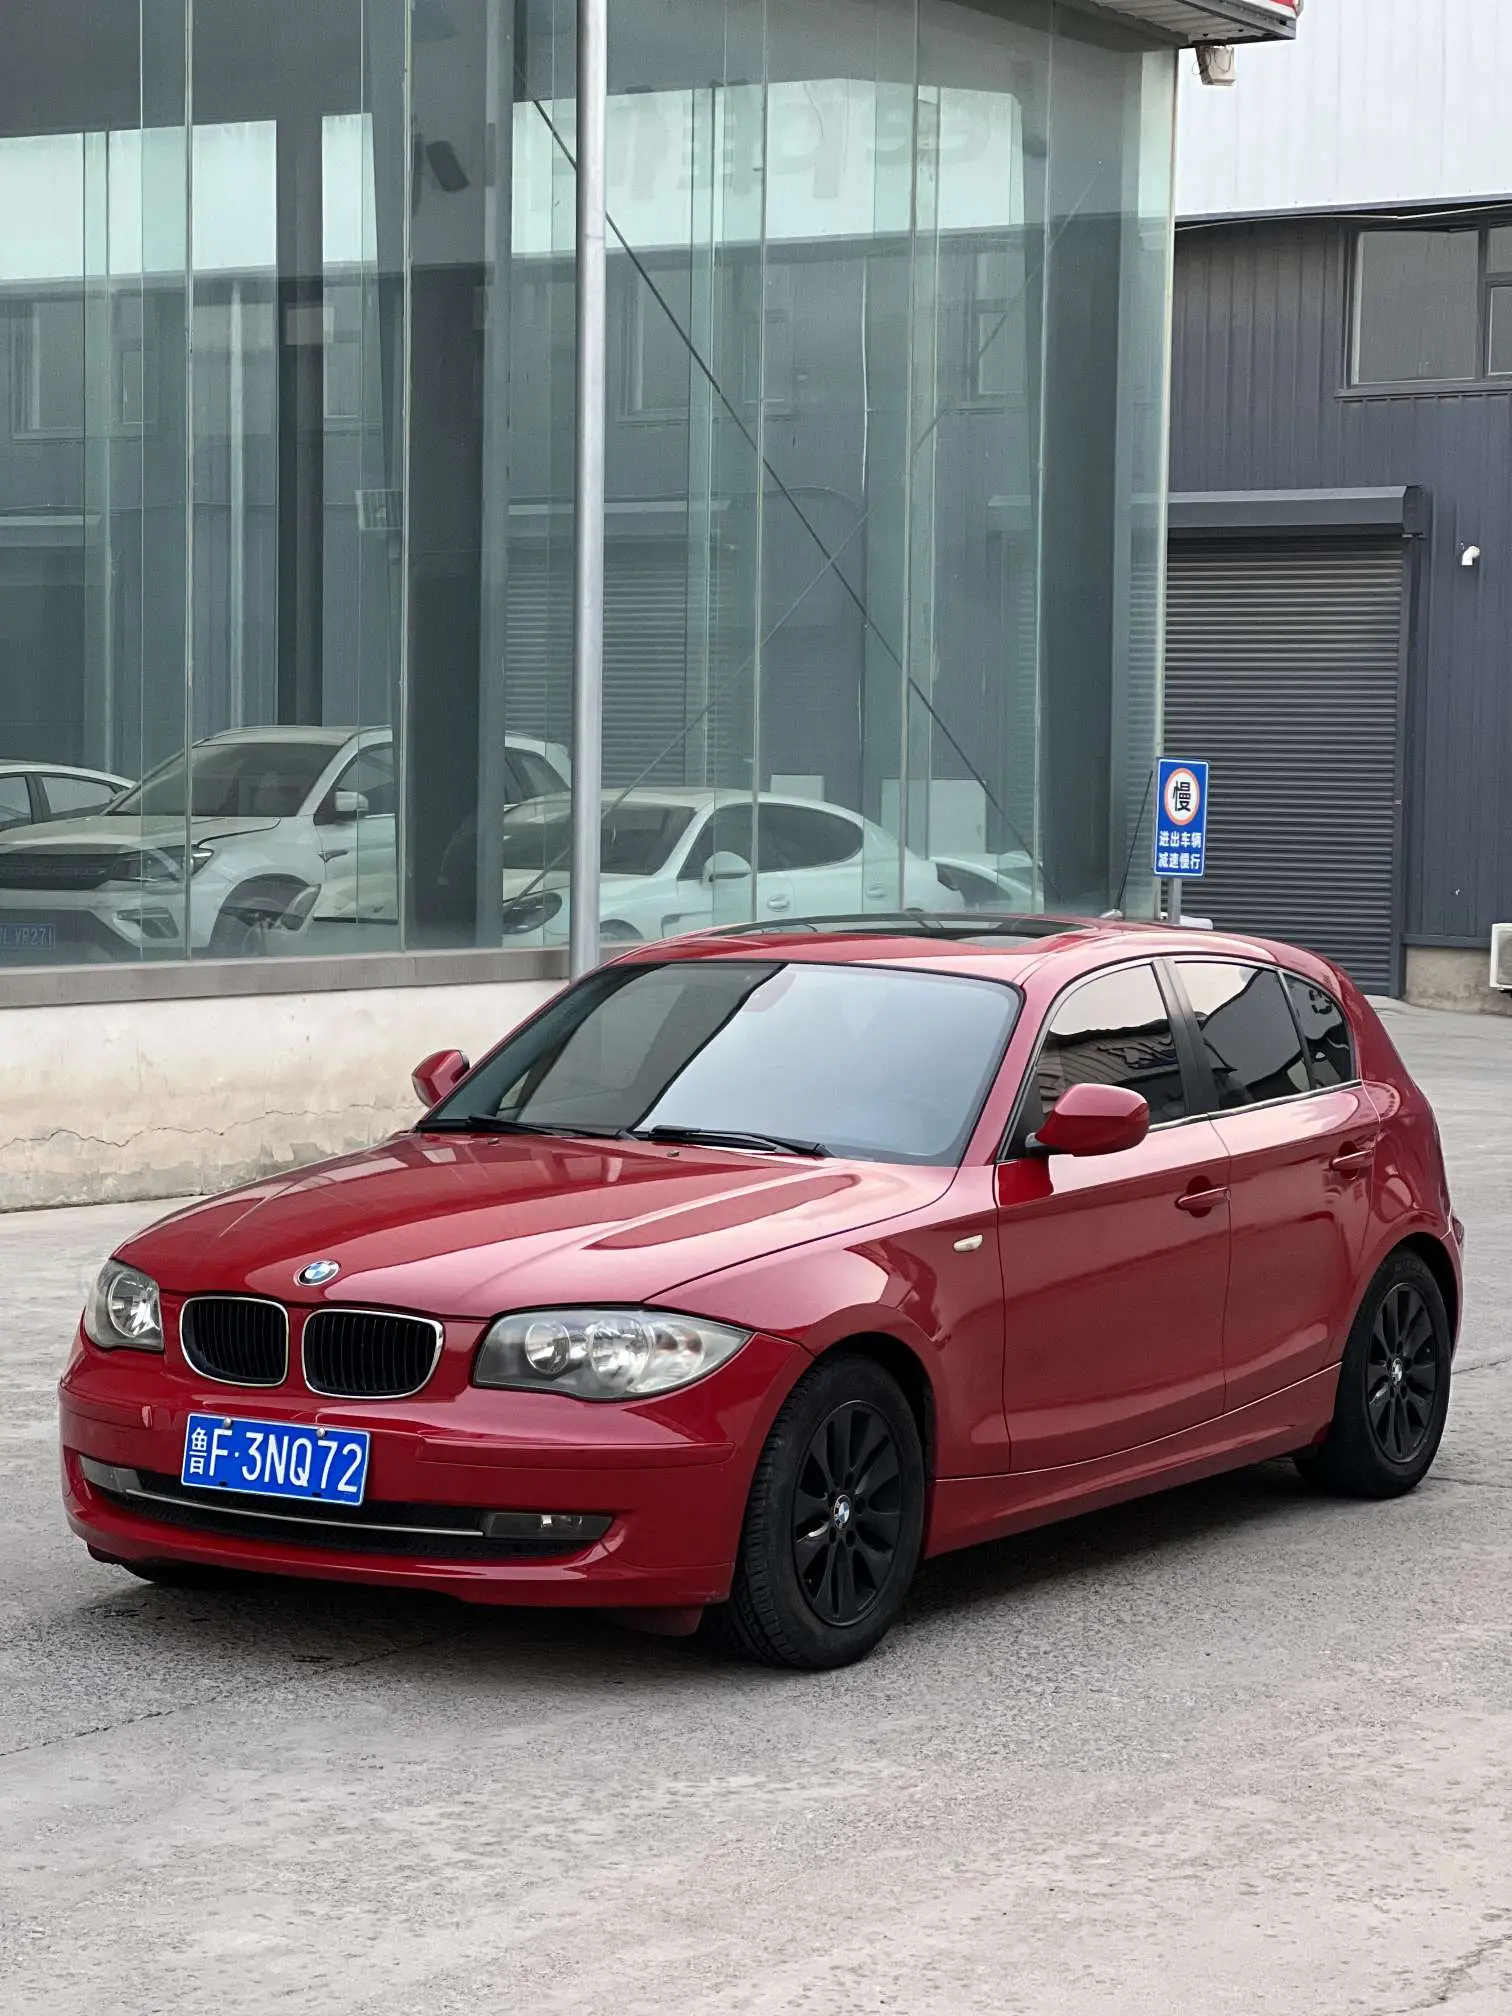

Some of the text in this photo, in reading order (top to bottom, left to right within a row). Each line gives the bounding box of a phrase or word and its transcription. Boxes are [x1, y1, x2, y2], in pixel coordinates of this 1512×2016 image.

[1172, 780, 1191, 812] 慢
[1158, 830, 1202, 849] 进出车辆
[1157, 852, 1201, 870] 减速慢行
